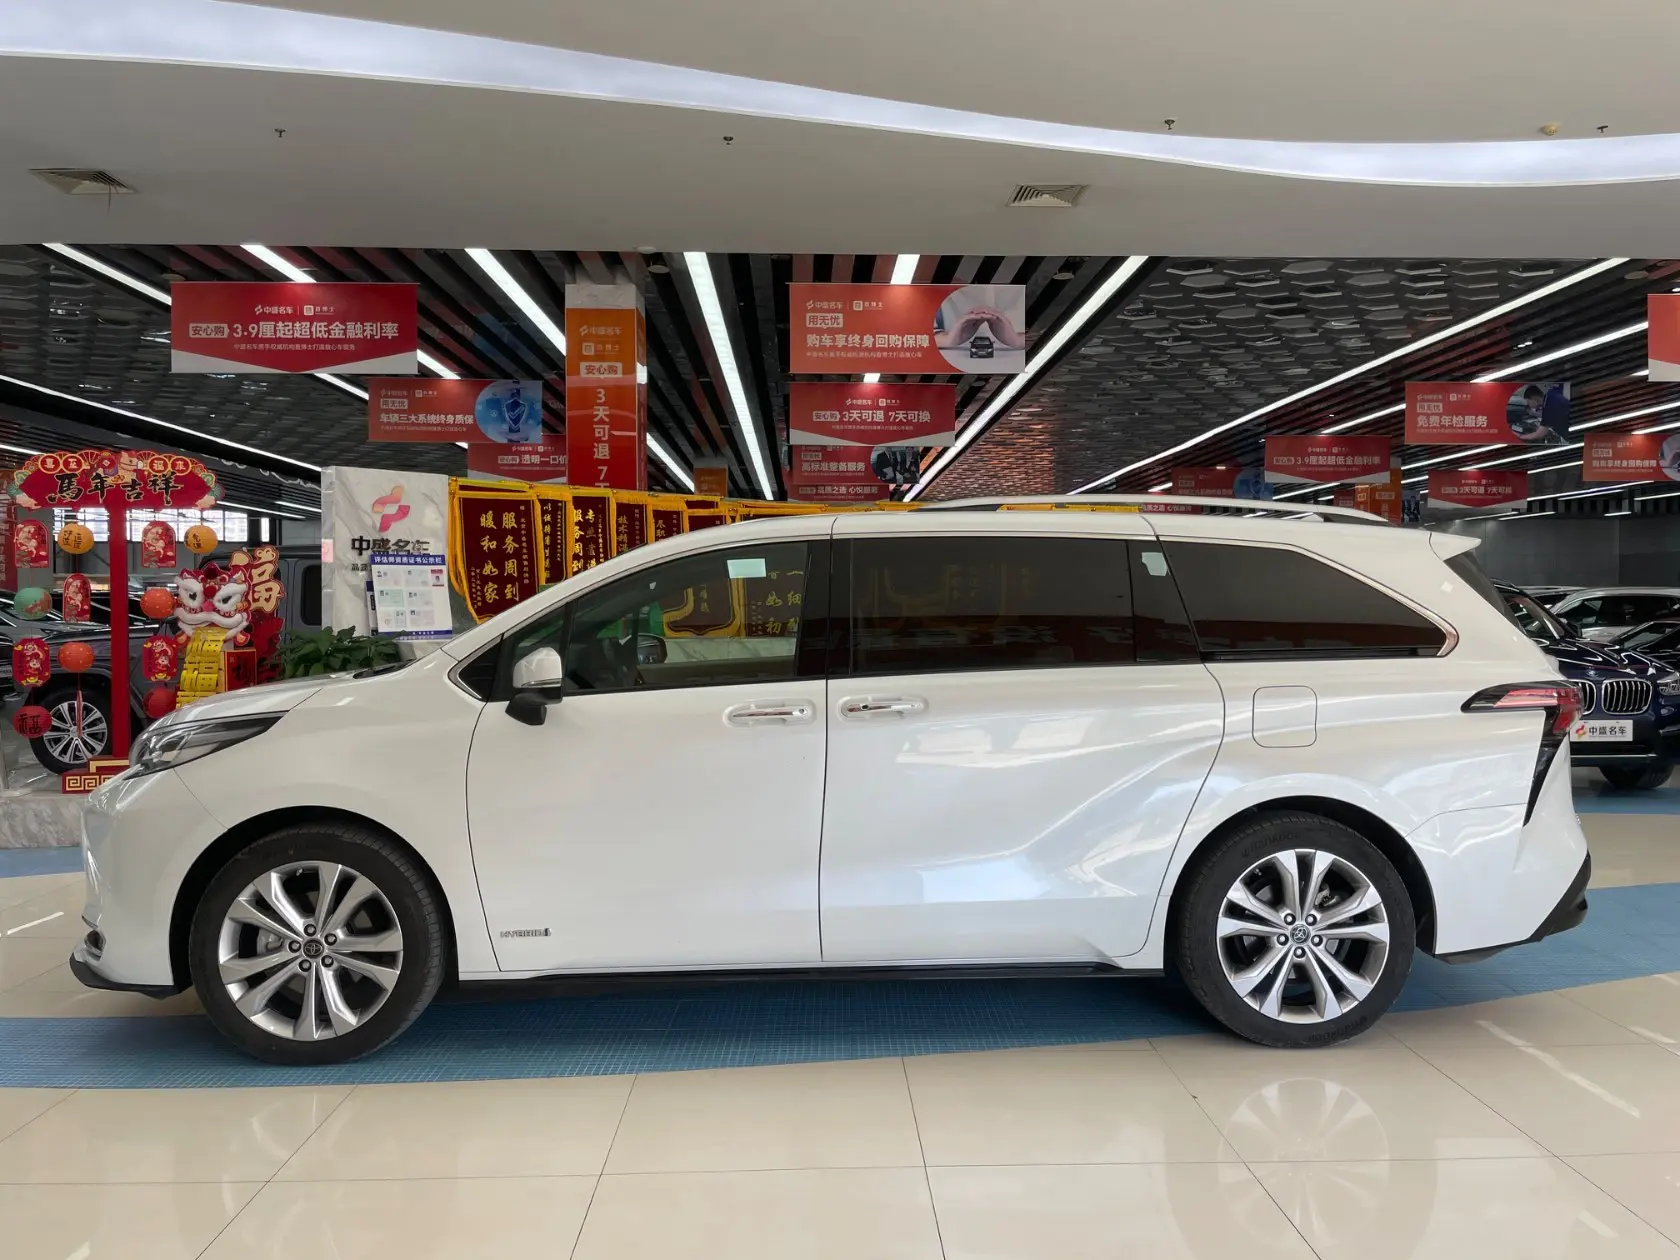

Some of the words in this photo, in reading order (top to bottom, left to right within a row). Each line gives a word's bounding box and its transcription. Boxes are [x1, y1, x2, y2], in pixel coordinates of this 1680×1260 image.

[807, 315, 841, 326] 用无忧
[191, 325, 225, 336] 安心购
[232, 321, 399, 339] 3.9厘起超低金融利率
[806, 334, 930, 348] 购车享终身回购保障
[585, 364, 618, 375] 安心购
[842, 410, 885, 422] 3天可退
[888, 411, 931, 423] 7天可换
[1417, 415, 1488, 427] 免费年检服务
[593, 388, 610, 460] 3天可退
[46, 467, 184, 506] 馬年吉祥
[502, 512, 519, 601] 服务周到
[1588, 726, 1627, 736] 中盛名车
